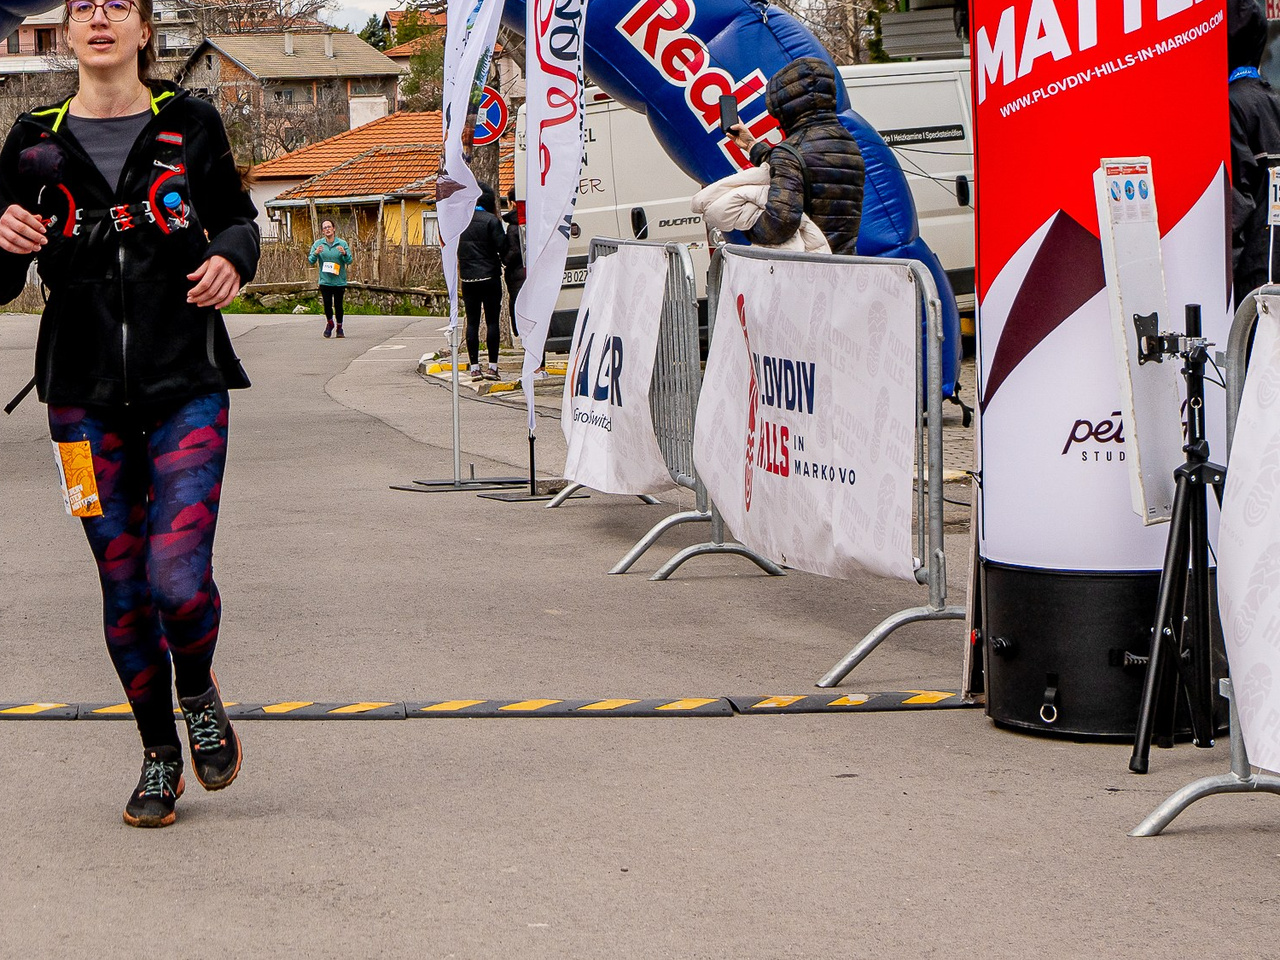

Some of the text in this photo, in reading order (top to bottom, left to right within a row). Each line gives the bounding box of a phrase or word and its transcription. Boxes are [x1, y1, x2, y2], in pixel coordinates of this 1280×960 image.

[1000, 10, 1224, 118] WWW.PLOVDIV-HILLS-IN-MARKOVO.COM
[658, 217, 701, 227] DUCATO
[793, 434, 805, 452] IN
[1082, 451, 1126, 462] STUD
[793, 459, 856, 486] MARKOVO
